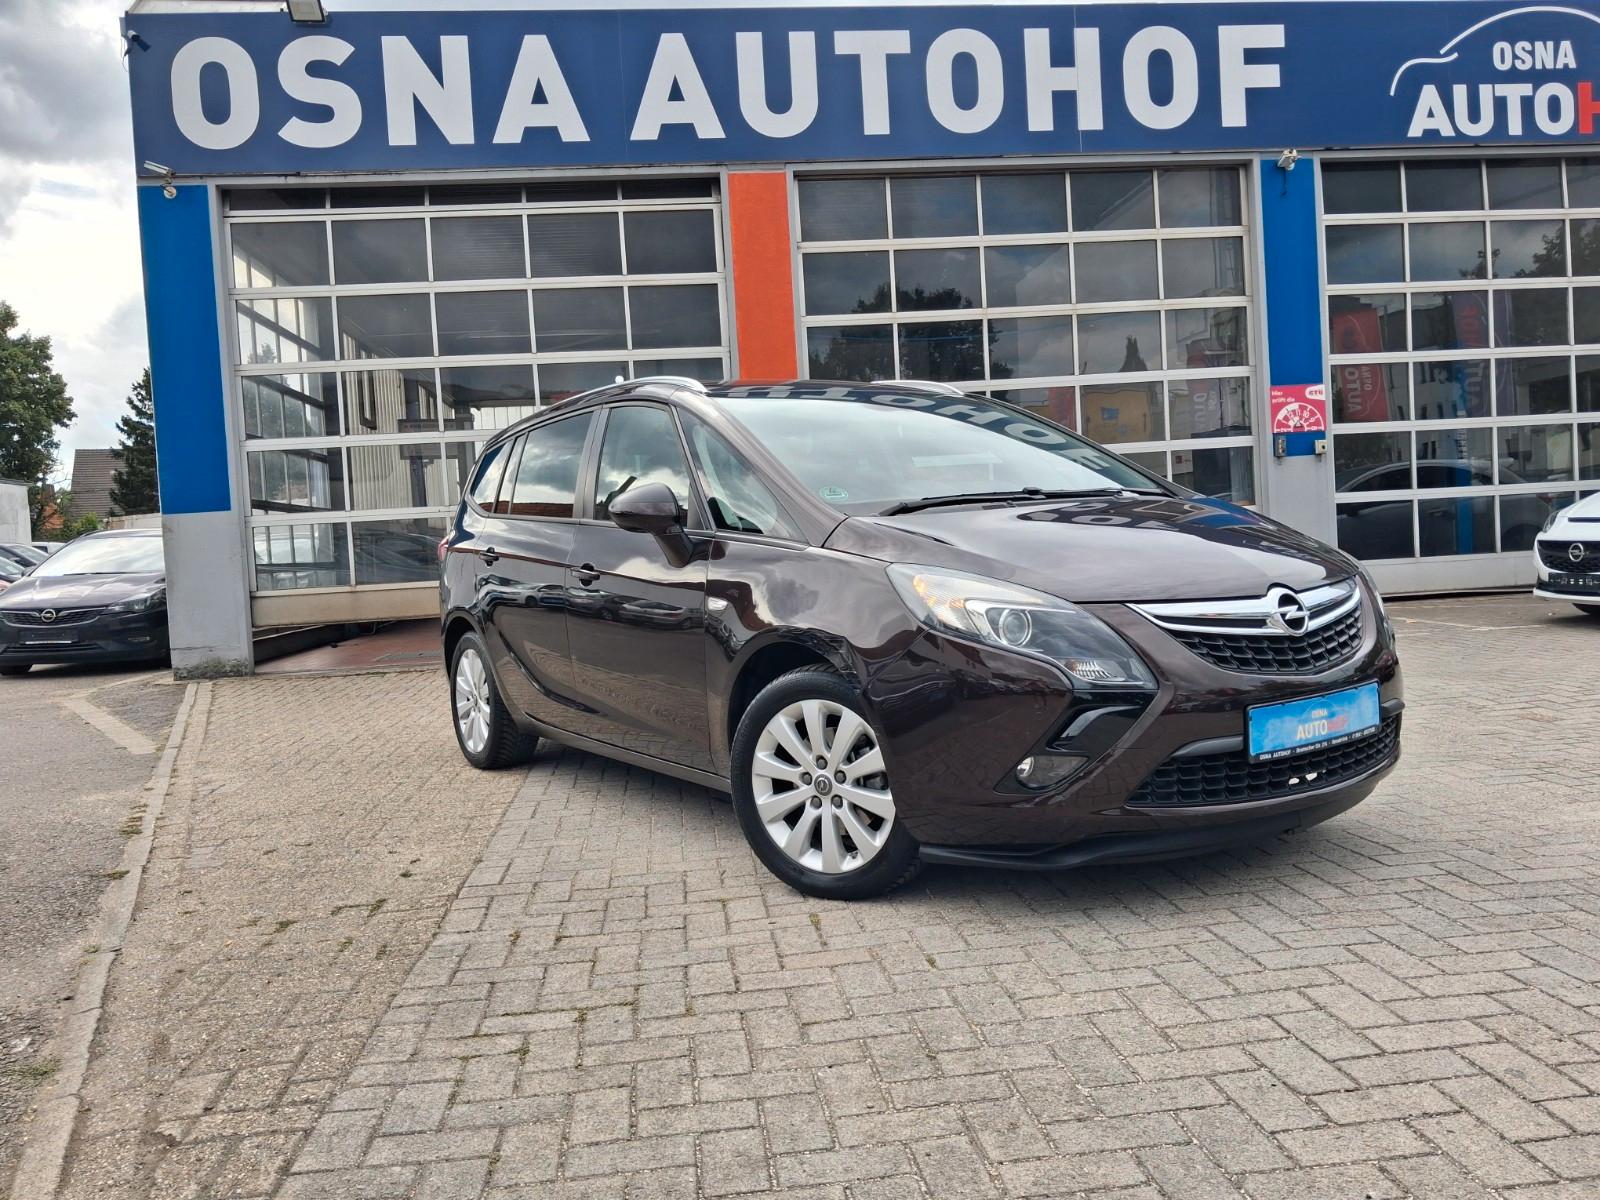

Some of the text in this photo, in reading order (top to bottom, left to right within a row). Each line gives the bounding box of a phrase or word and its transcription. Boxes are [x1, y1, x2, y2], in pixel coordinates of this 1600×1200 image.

[171, 24, 1285, 149] OSNA AUTOHOF
[1492, 40, 1577, 71] OSNA
